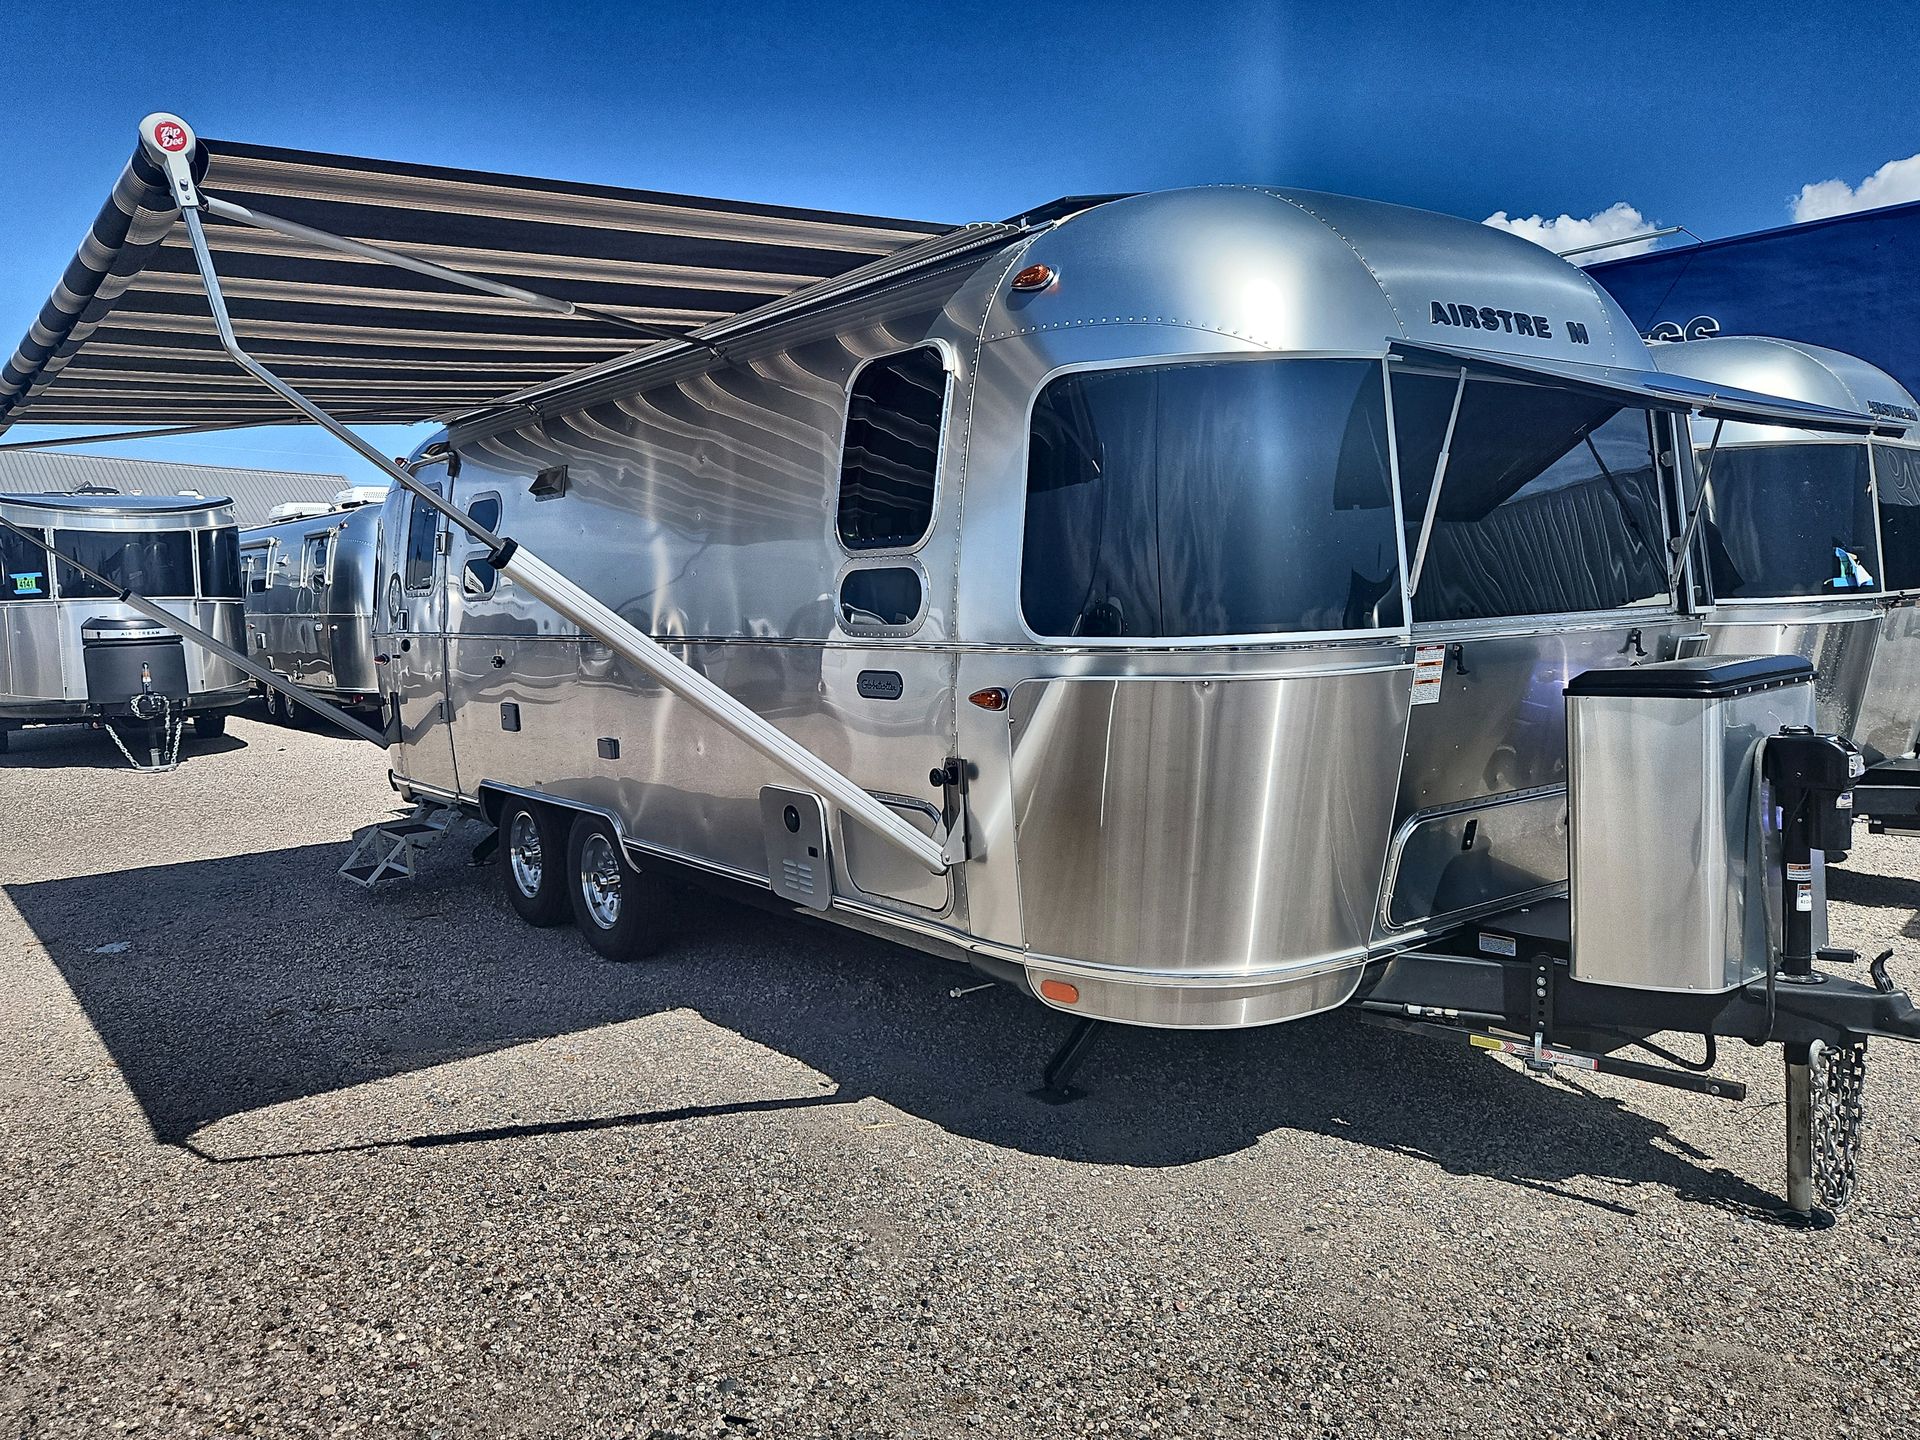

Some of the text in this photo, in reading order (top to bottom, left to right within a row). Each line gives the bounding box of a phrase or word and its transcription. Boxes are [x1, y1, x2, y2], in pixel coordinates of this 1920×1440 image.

[161, 126, 181, 138] Zip
[162, 137, 184, 148] Dee
[1431, 301, 1590, 344] AIRSTRE M
